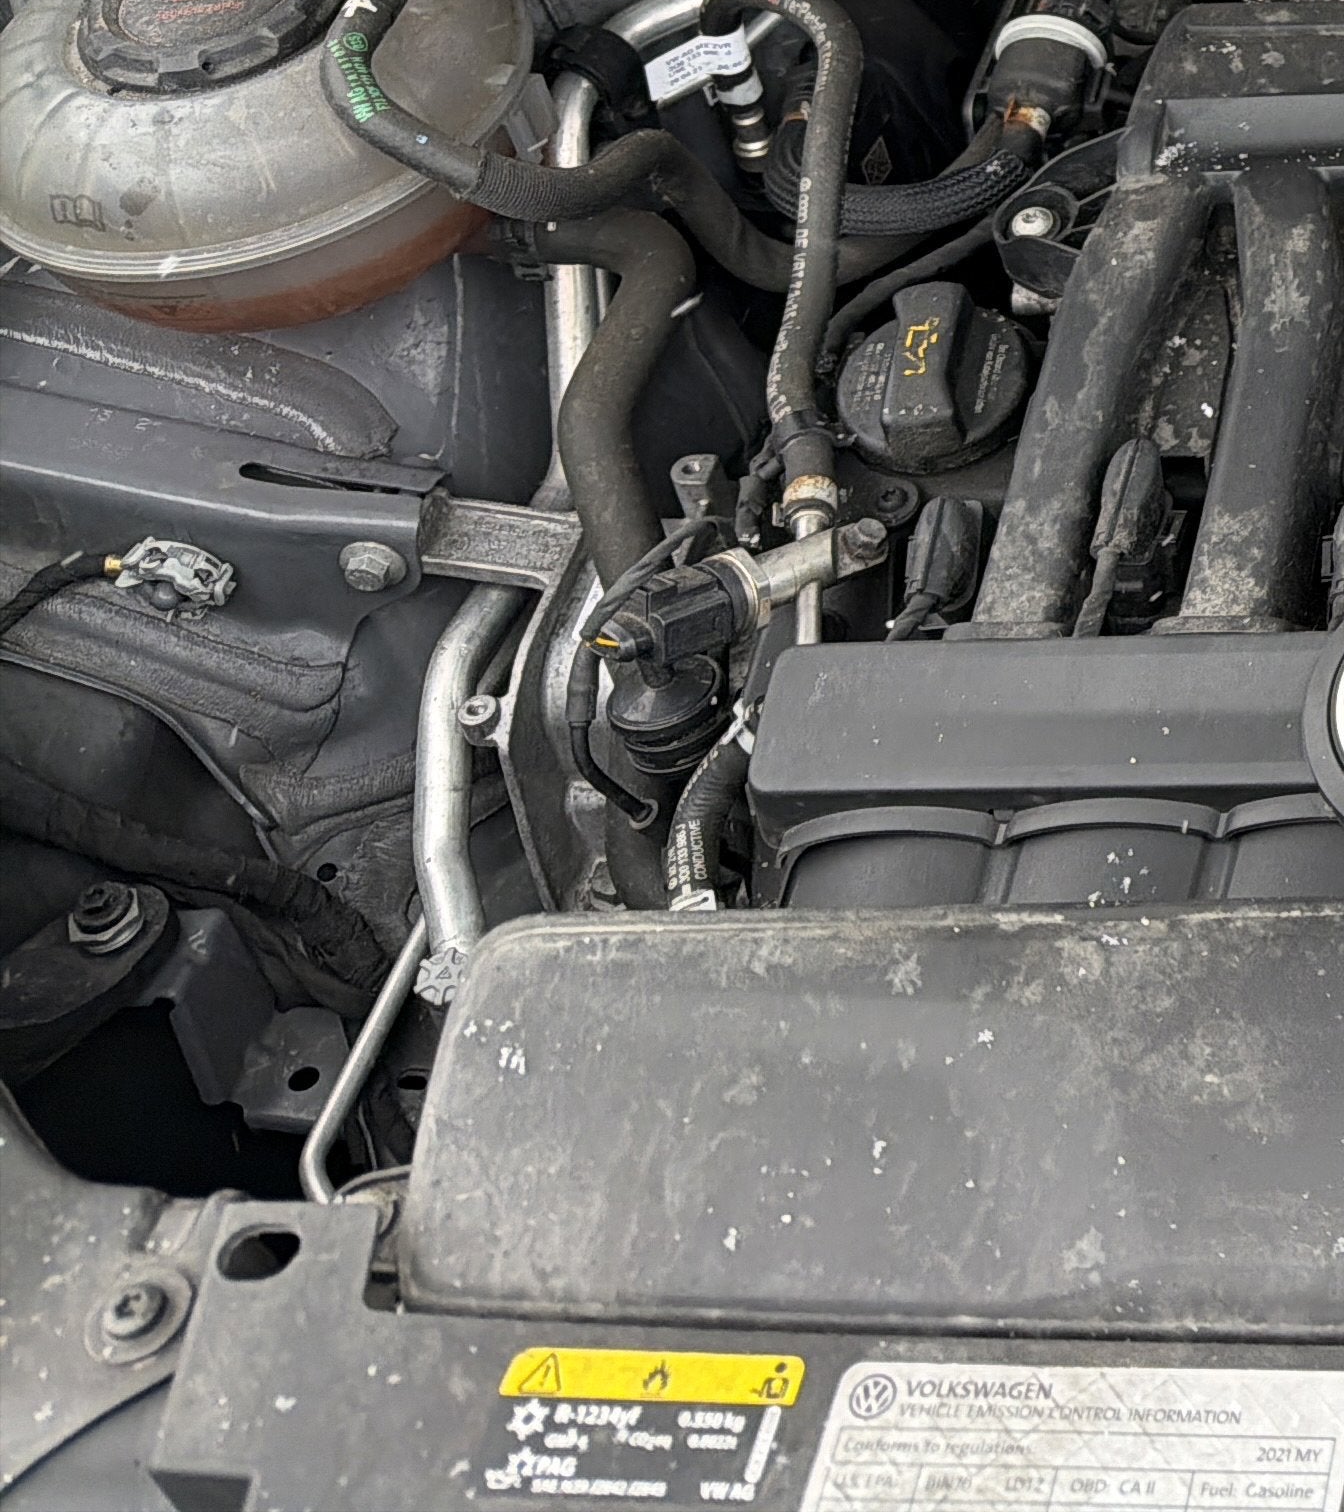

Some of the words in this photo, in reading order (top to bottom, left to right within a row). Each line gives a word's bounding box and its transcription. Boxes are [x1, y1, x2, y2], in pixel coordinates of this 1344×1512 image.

[688, 819, 708, 880] CONDUCTIVE
[906, 1380, 1054, 1400] VOLKSWAGEN
[899, 1403, 960, 1419] VEHICLE
[966, 1404, 1046, 1420] EMISSION
[1049, 1405, 1121, 1422] CONTROL
[1127, 1407, 1243, 1425] INFORMATION
[843, 1438, 919, 1453] Conforms
[923, 1438, 940, 1453] to
[1256, 1446, 1292, 1463] 2021
[1295, 1447, 1324, 1463] MY
[535, 1455, 577, 1477] PAG
[700, 1480, 730, 1500] VW
[729, 1482, 755, 1502] AG
[1245, 1484, 1315, 1500] Gasoline
